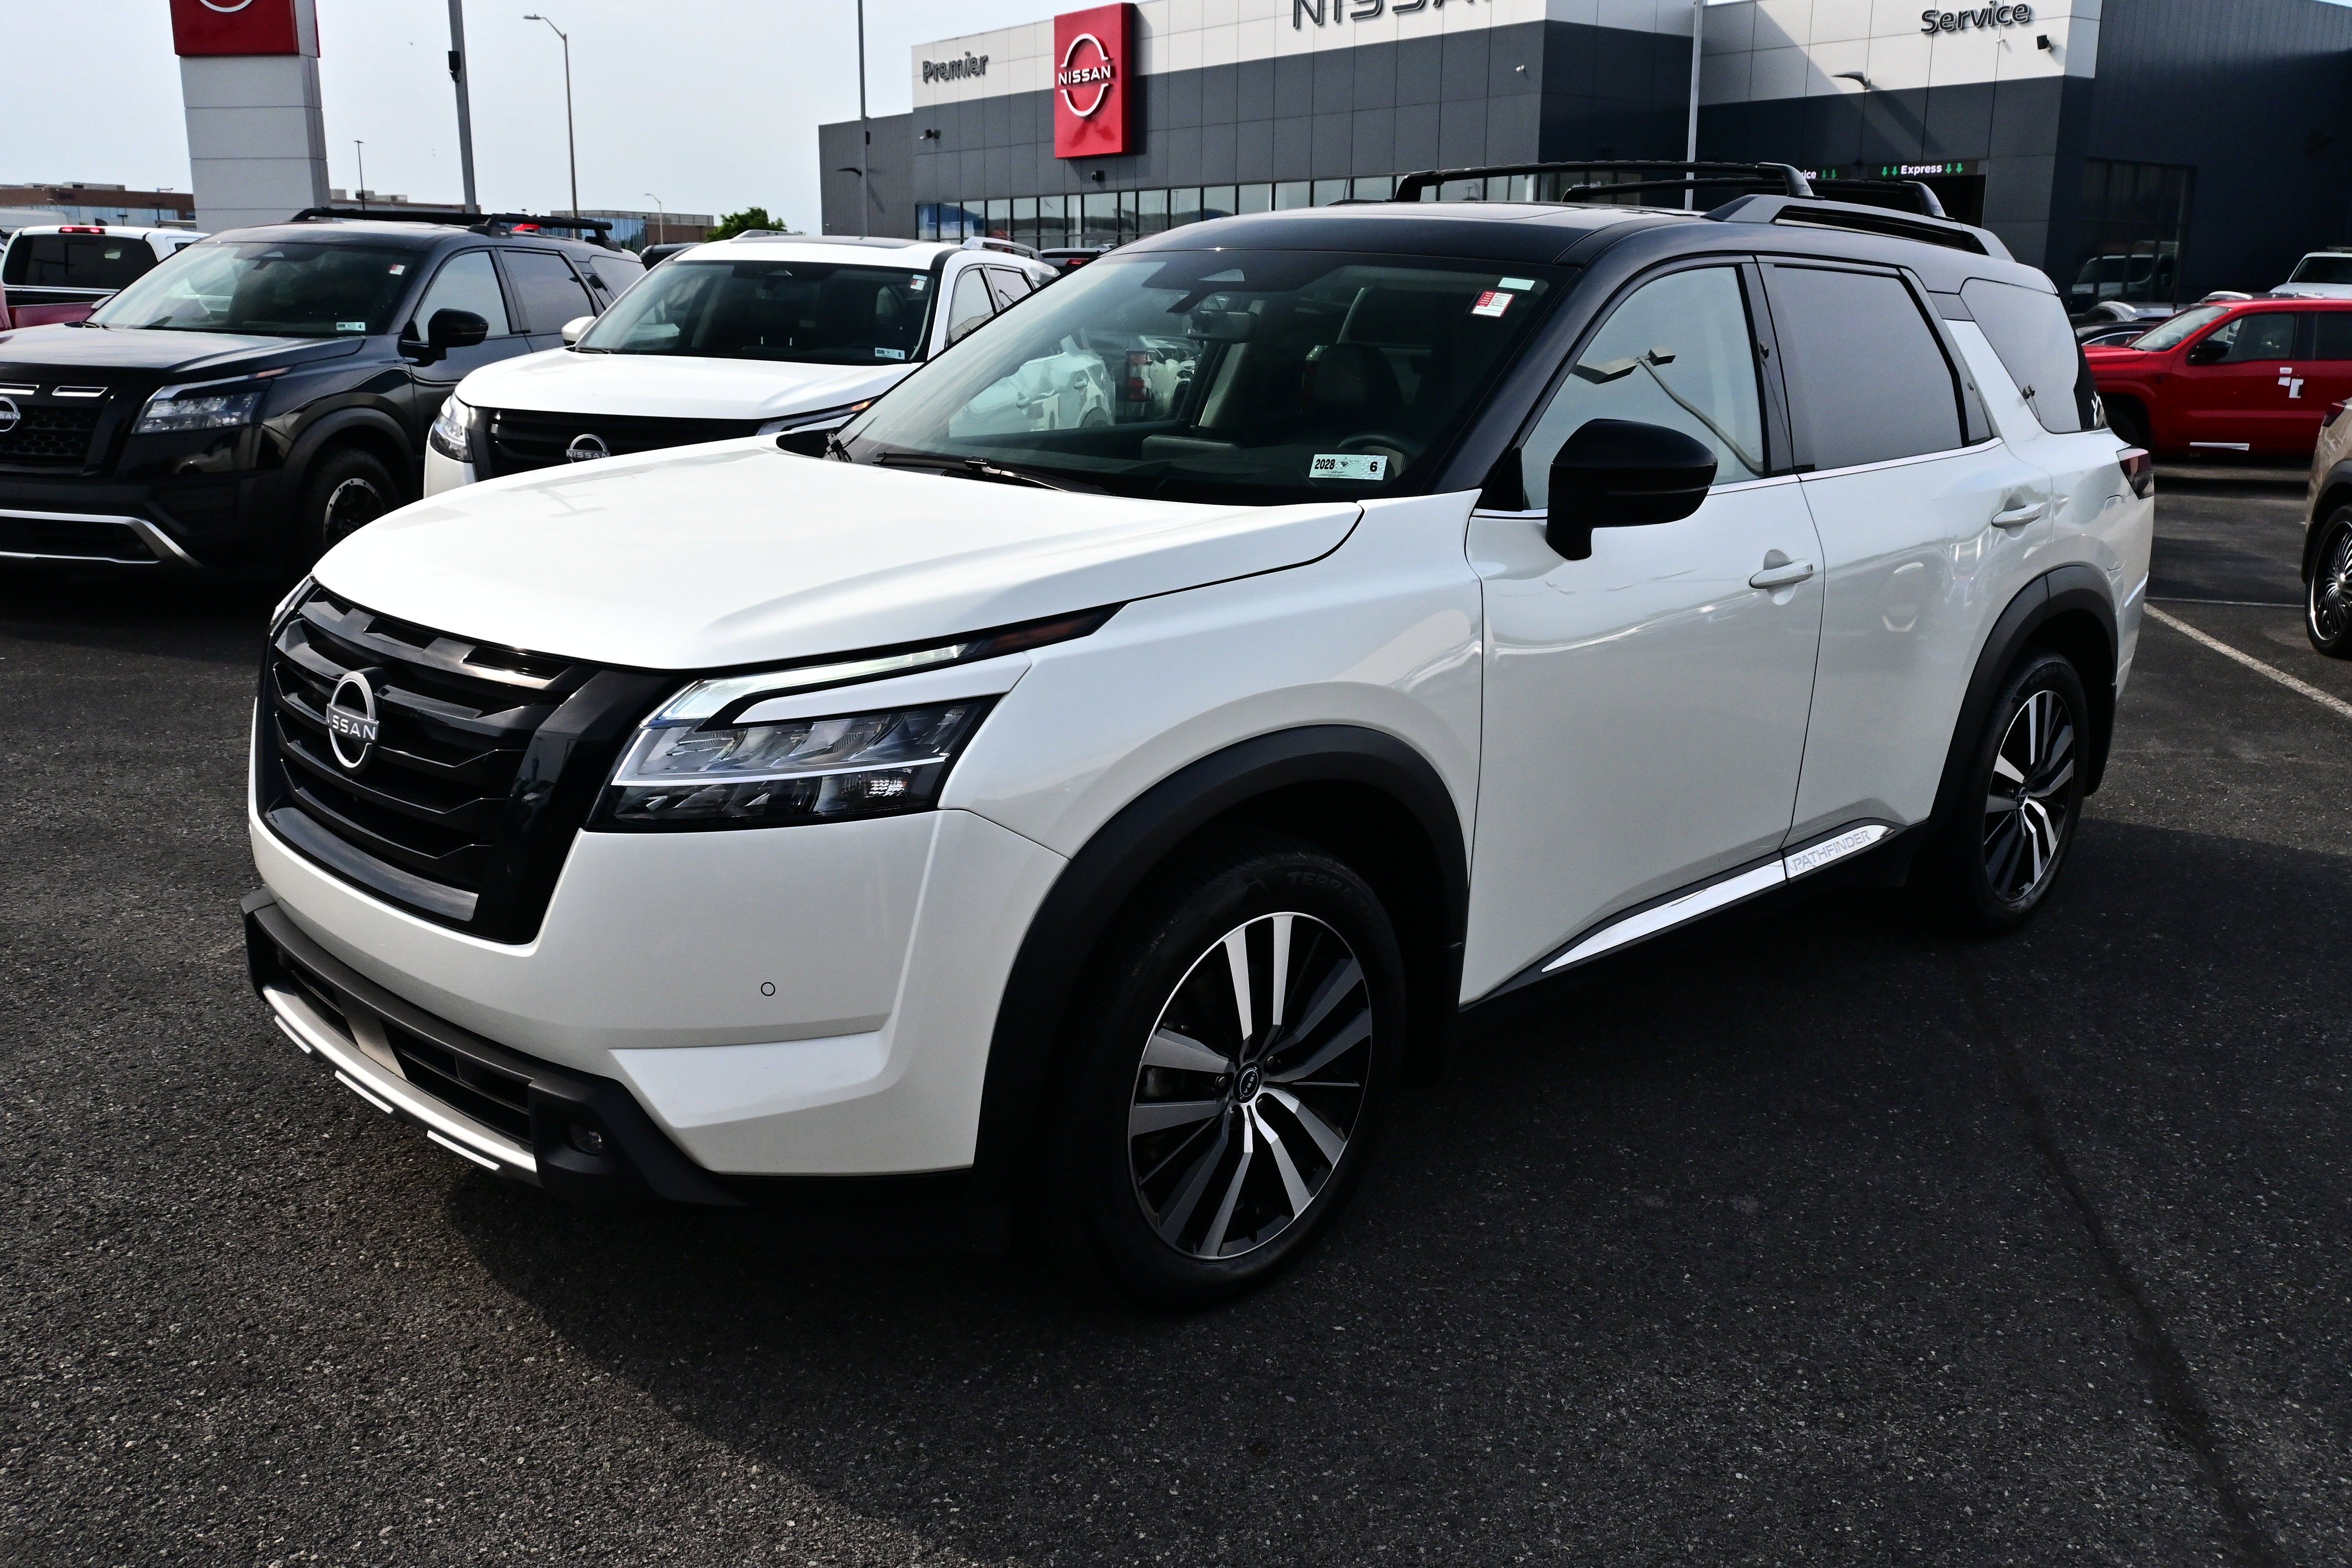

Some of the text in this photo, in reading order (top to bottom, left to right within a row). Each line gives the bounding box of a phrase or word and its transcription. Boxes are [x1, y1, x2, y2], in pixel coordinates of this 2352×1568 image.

[1921, 0, 2029, 33] Service
[923, 51, 988, 84] Premier
[1059, 65, 1111, 85] NISSAN
[1901, 165, 1942, 176] Express
[1315, 459, 1378, 472] 2028 6
[1792, 830, 1871, 871] PATHFINDER
[1239, 1067, 1258, 1100] NISSAN
